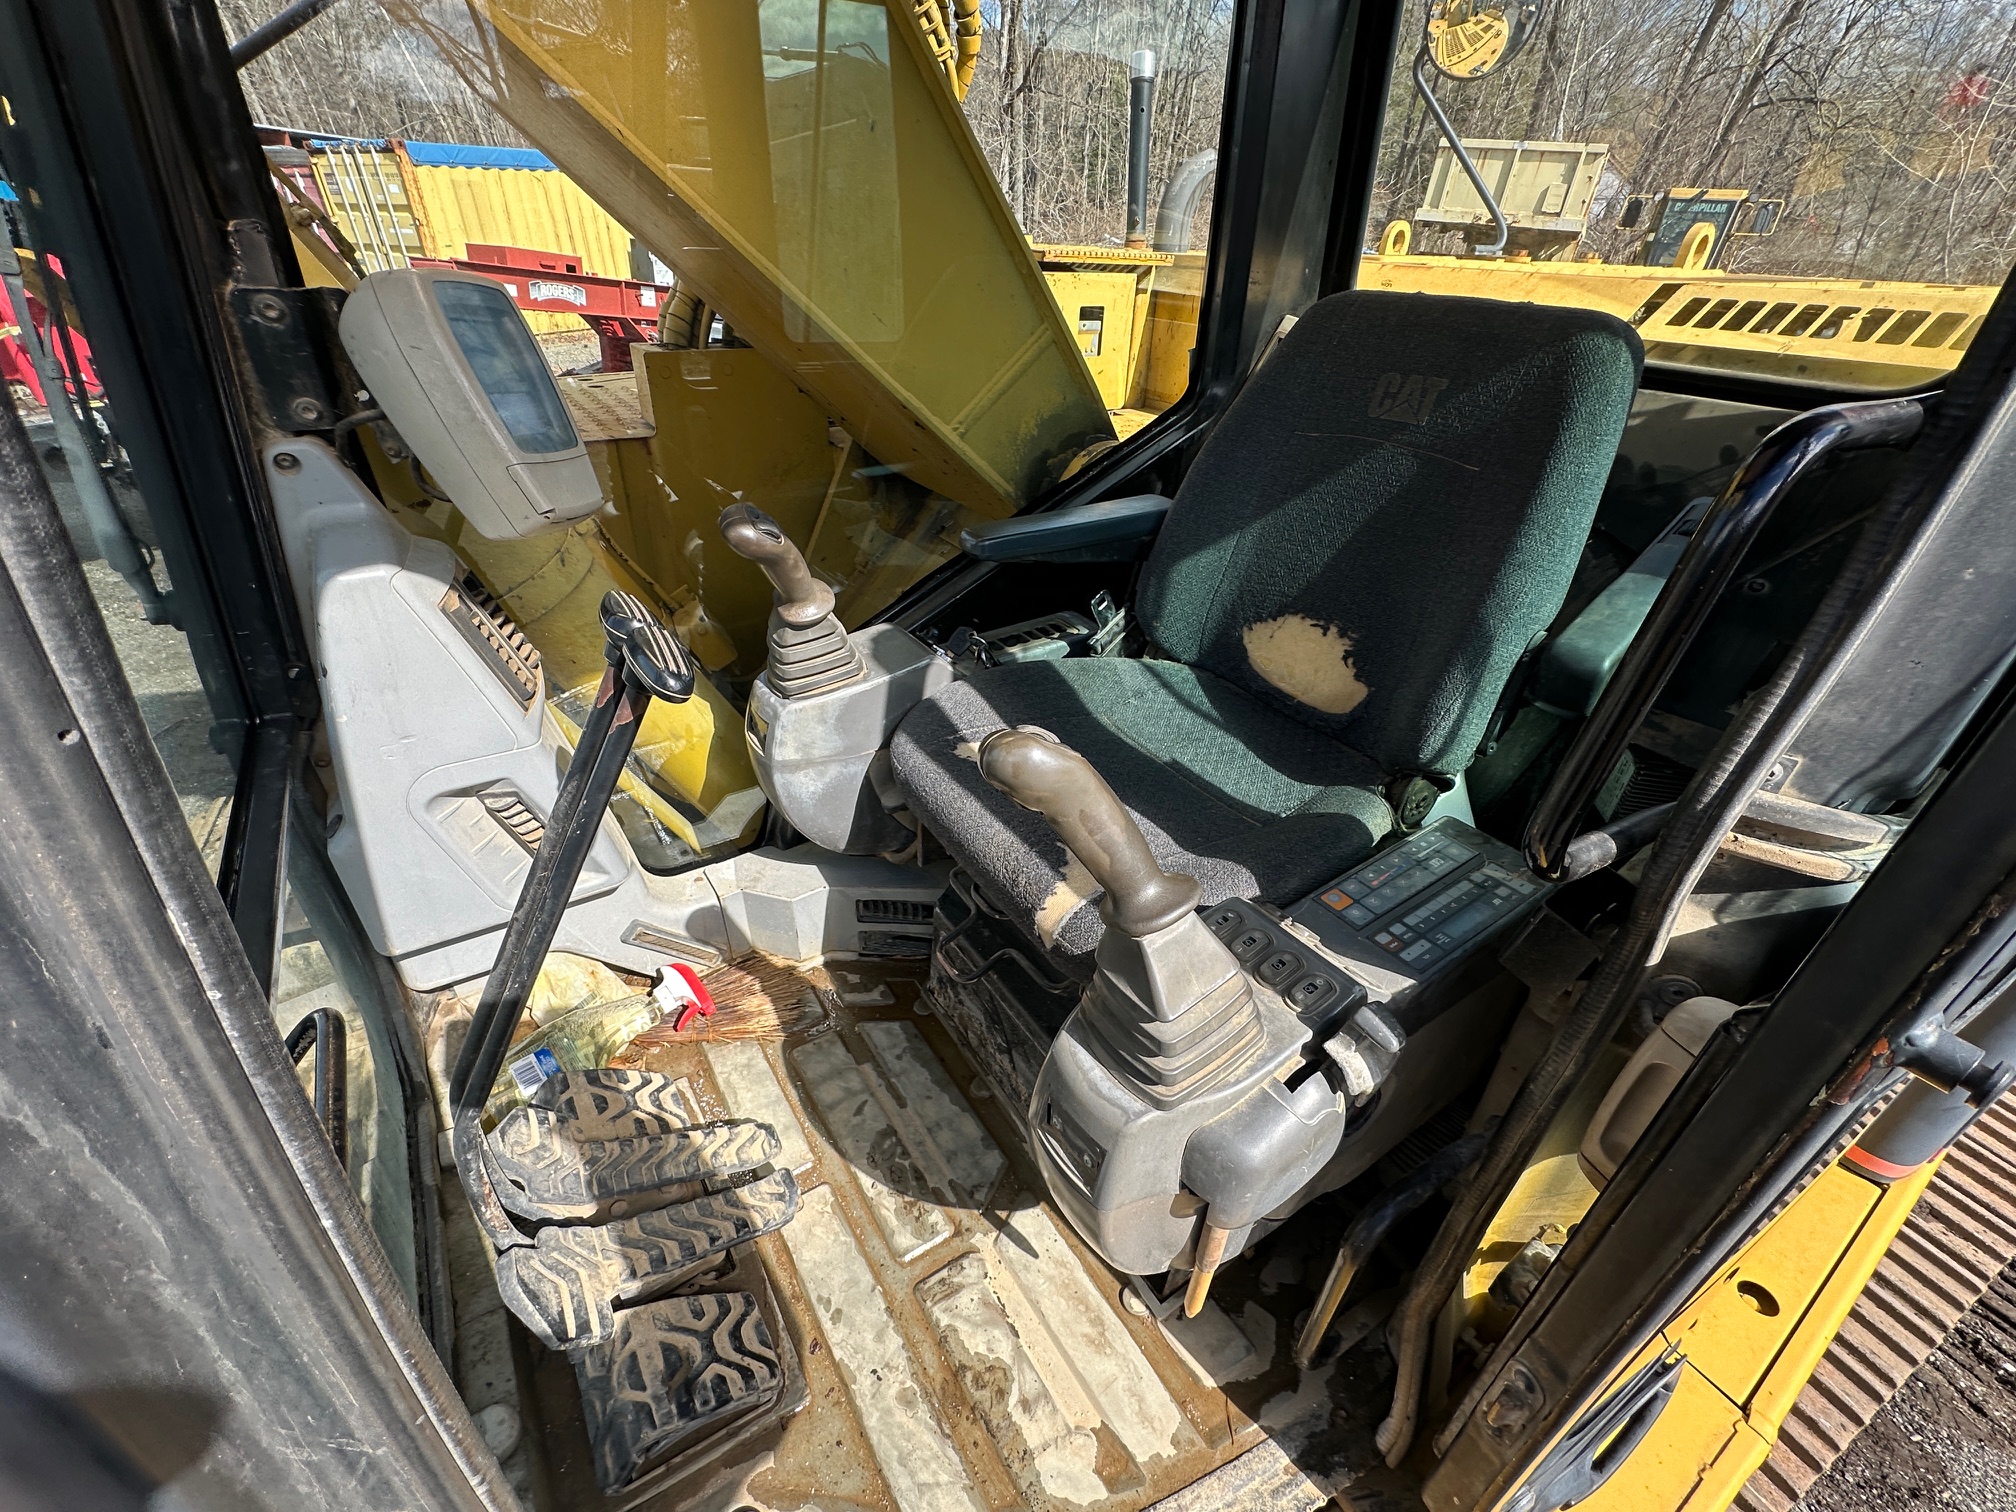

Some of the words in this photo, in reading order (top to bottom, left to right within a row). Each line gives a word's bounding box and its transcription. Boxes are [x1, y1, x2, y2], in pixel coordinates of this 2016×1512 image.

[1674, 201, 1728, 213] CRPILLAR
[540, 284, 575, 300] ROGERS
[1367, 372, 1450, 425] CAT
